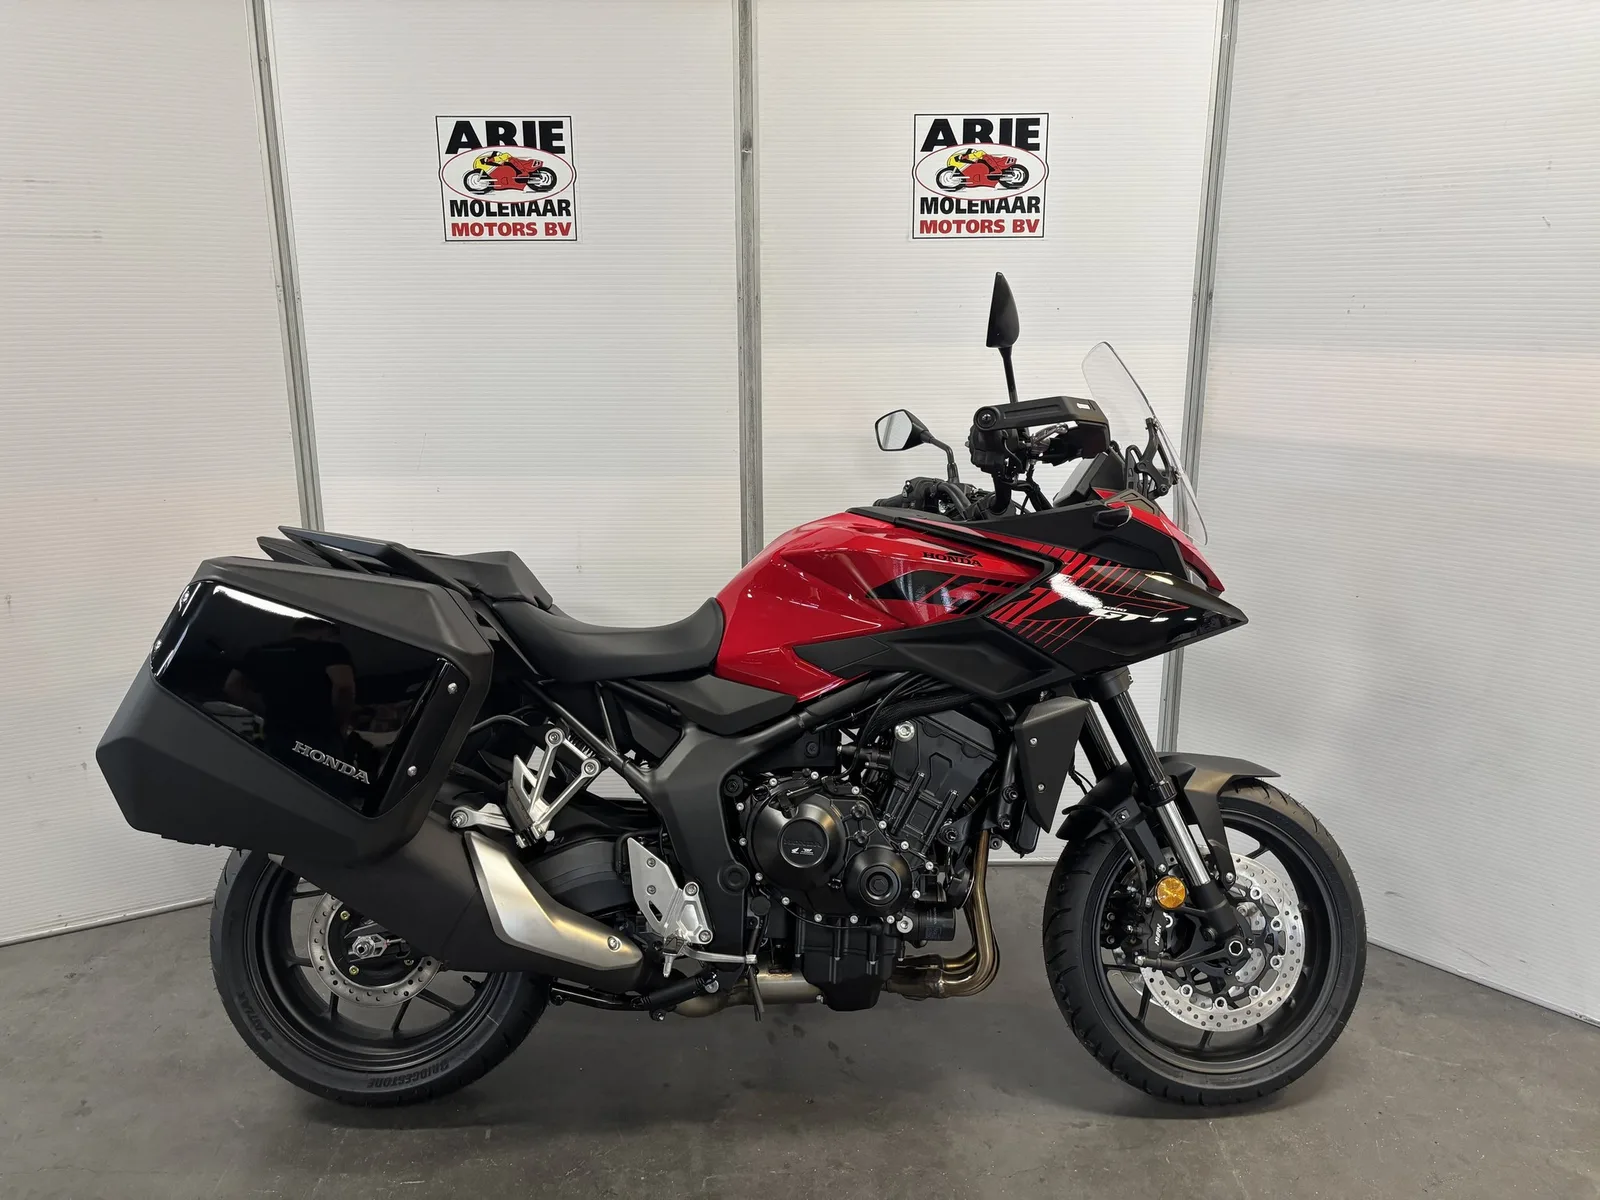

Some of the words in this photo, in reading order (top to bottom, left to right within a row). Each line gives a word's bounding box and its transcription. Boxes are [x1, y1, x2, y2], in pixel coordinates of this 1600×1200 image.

[445, 120, 566, 154] ARIE
[920, 118, 1041, 152] ARIE
[449, 199, 572, 217] MOLENAAR
[920, 196, 1041, 214] MOLENAAR
[451, 222, 538, 237] MOTORS
[544, 222, 572, 237] BV
[919, 219, 1006, 234] MOTORS
[1012, 218, 1041, 233] BV
[922, 552, 984, 567] HONDA
[291, 740, 371, 785] HONDA
[366, 1060, 450, 1089] BRIDGESTONE
